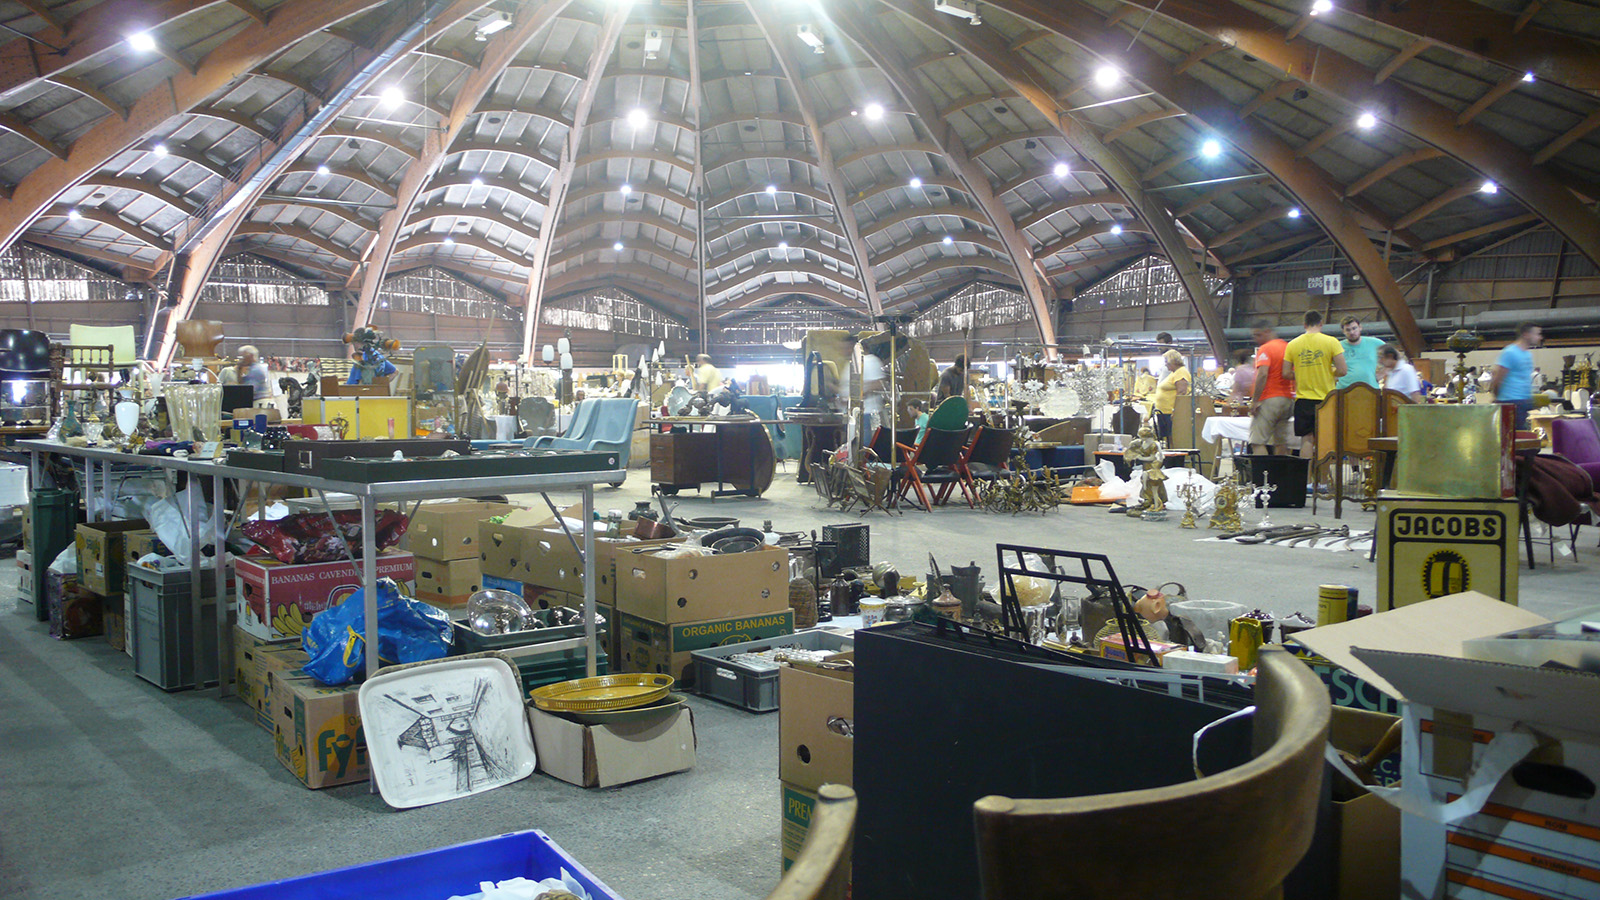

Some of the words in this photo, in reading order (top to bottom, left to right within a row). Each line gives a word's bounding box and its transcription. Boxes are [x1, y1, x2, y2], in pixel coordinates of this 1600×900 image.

[1397, 515, 1497, 537] JACOBS
[271, 572, 315, 584] BANANAS
[319, 568, 364, 580] CAVEND
[682, 622, 732, 637] ORGANIC
[735, 615, 785, 631] BANANAS
